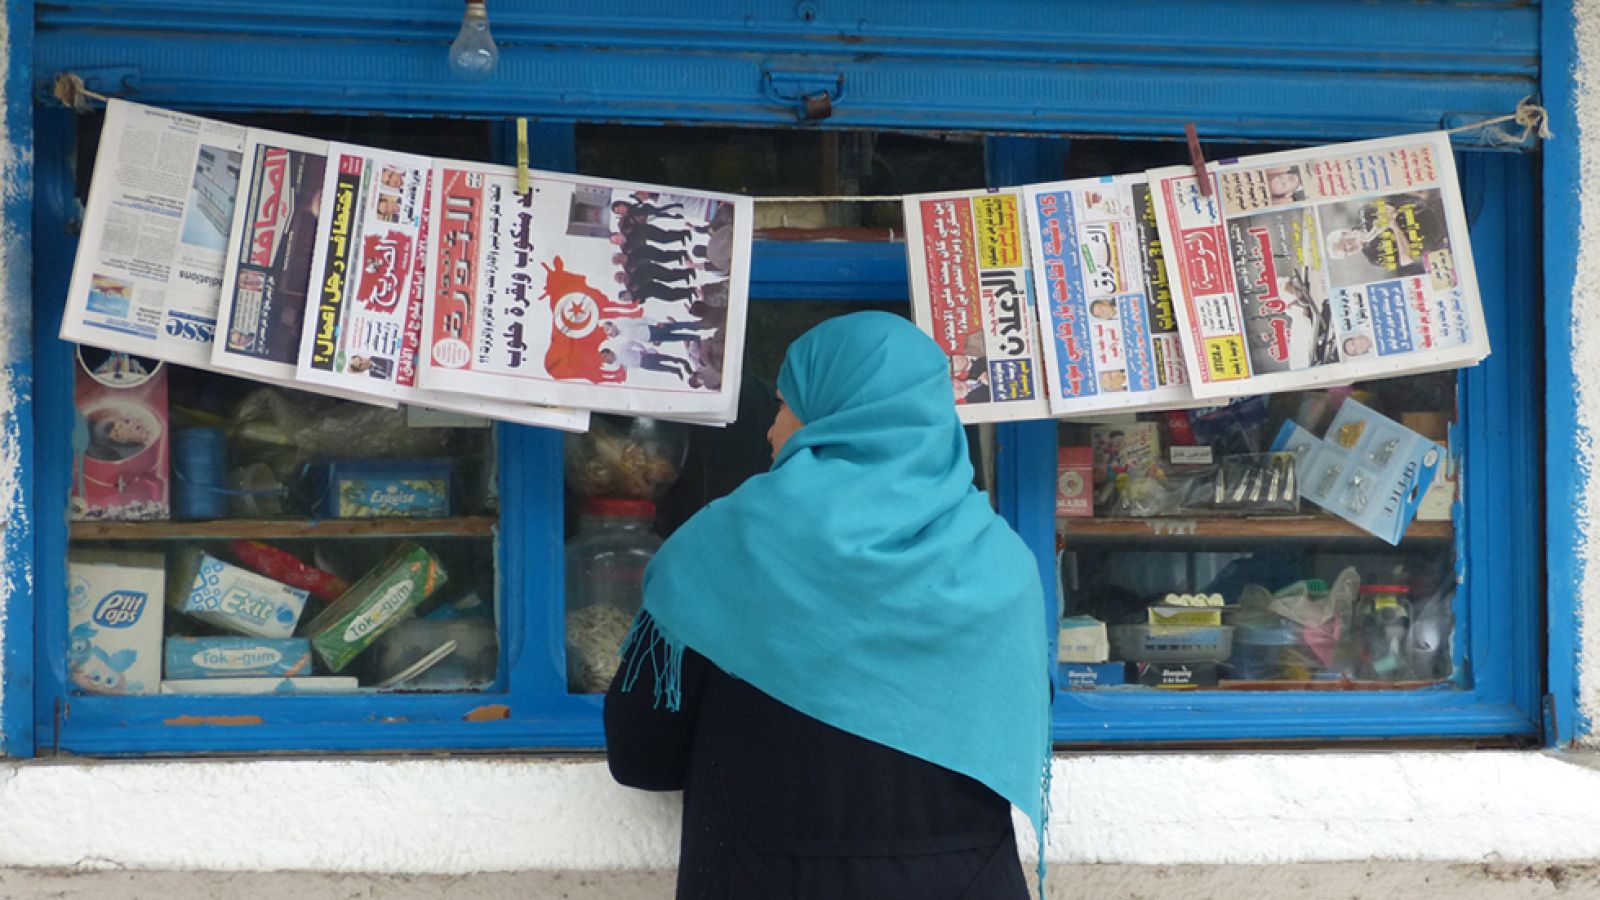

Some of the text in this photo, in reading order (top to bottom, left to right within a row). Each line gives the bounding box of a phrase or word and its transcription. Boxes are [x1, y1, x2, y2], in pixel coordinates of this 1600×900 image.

[248, 145, 287, 268] الصحافة
[326, 181, 353, 257] اختطاف
[1038, 193, 1058, 217] 15
[1039, 217, 1068, 256] دقيقة
[322, 258, 346, 303] رجل
[368, 236, 402, 307] الصريح
[437, 194, 475, 339] الثورة
[500, 184, 540, 368] بلد منكوب وبقرة حلوب
[1083, 222, 1117, 295] الشروق
[1181, 229, 1222, 291] التونسية
[1244, 225, 1287, 315] استنطاق
[979, 269, 1032, 355] الإعلان
[1060, 362, 1085, 396] سوسة
[220, 587, 274, 621] Exit
